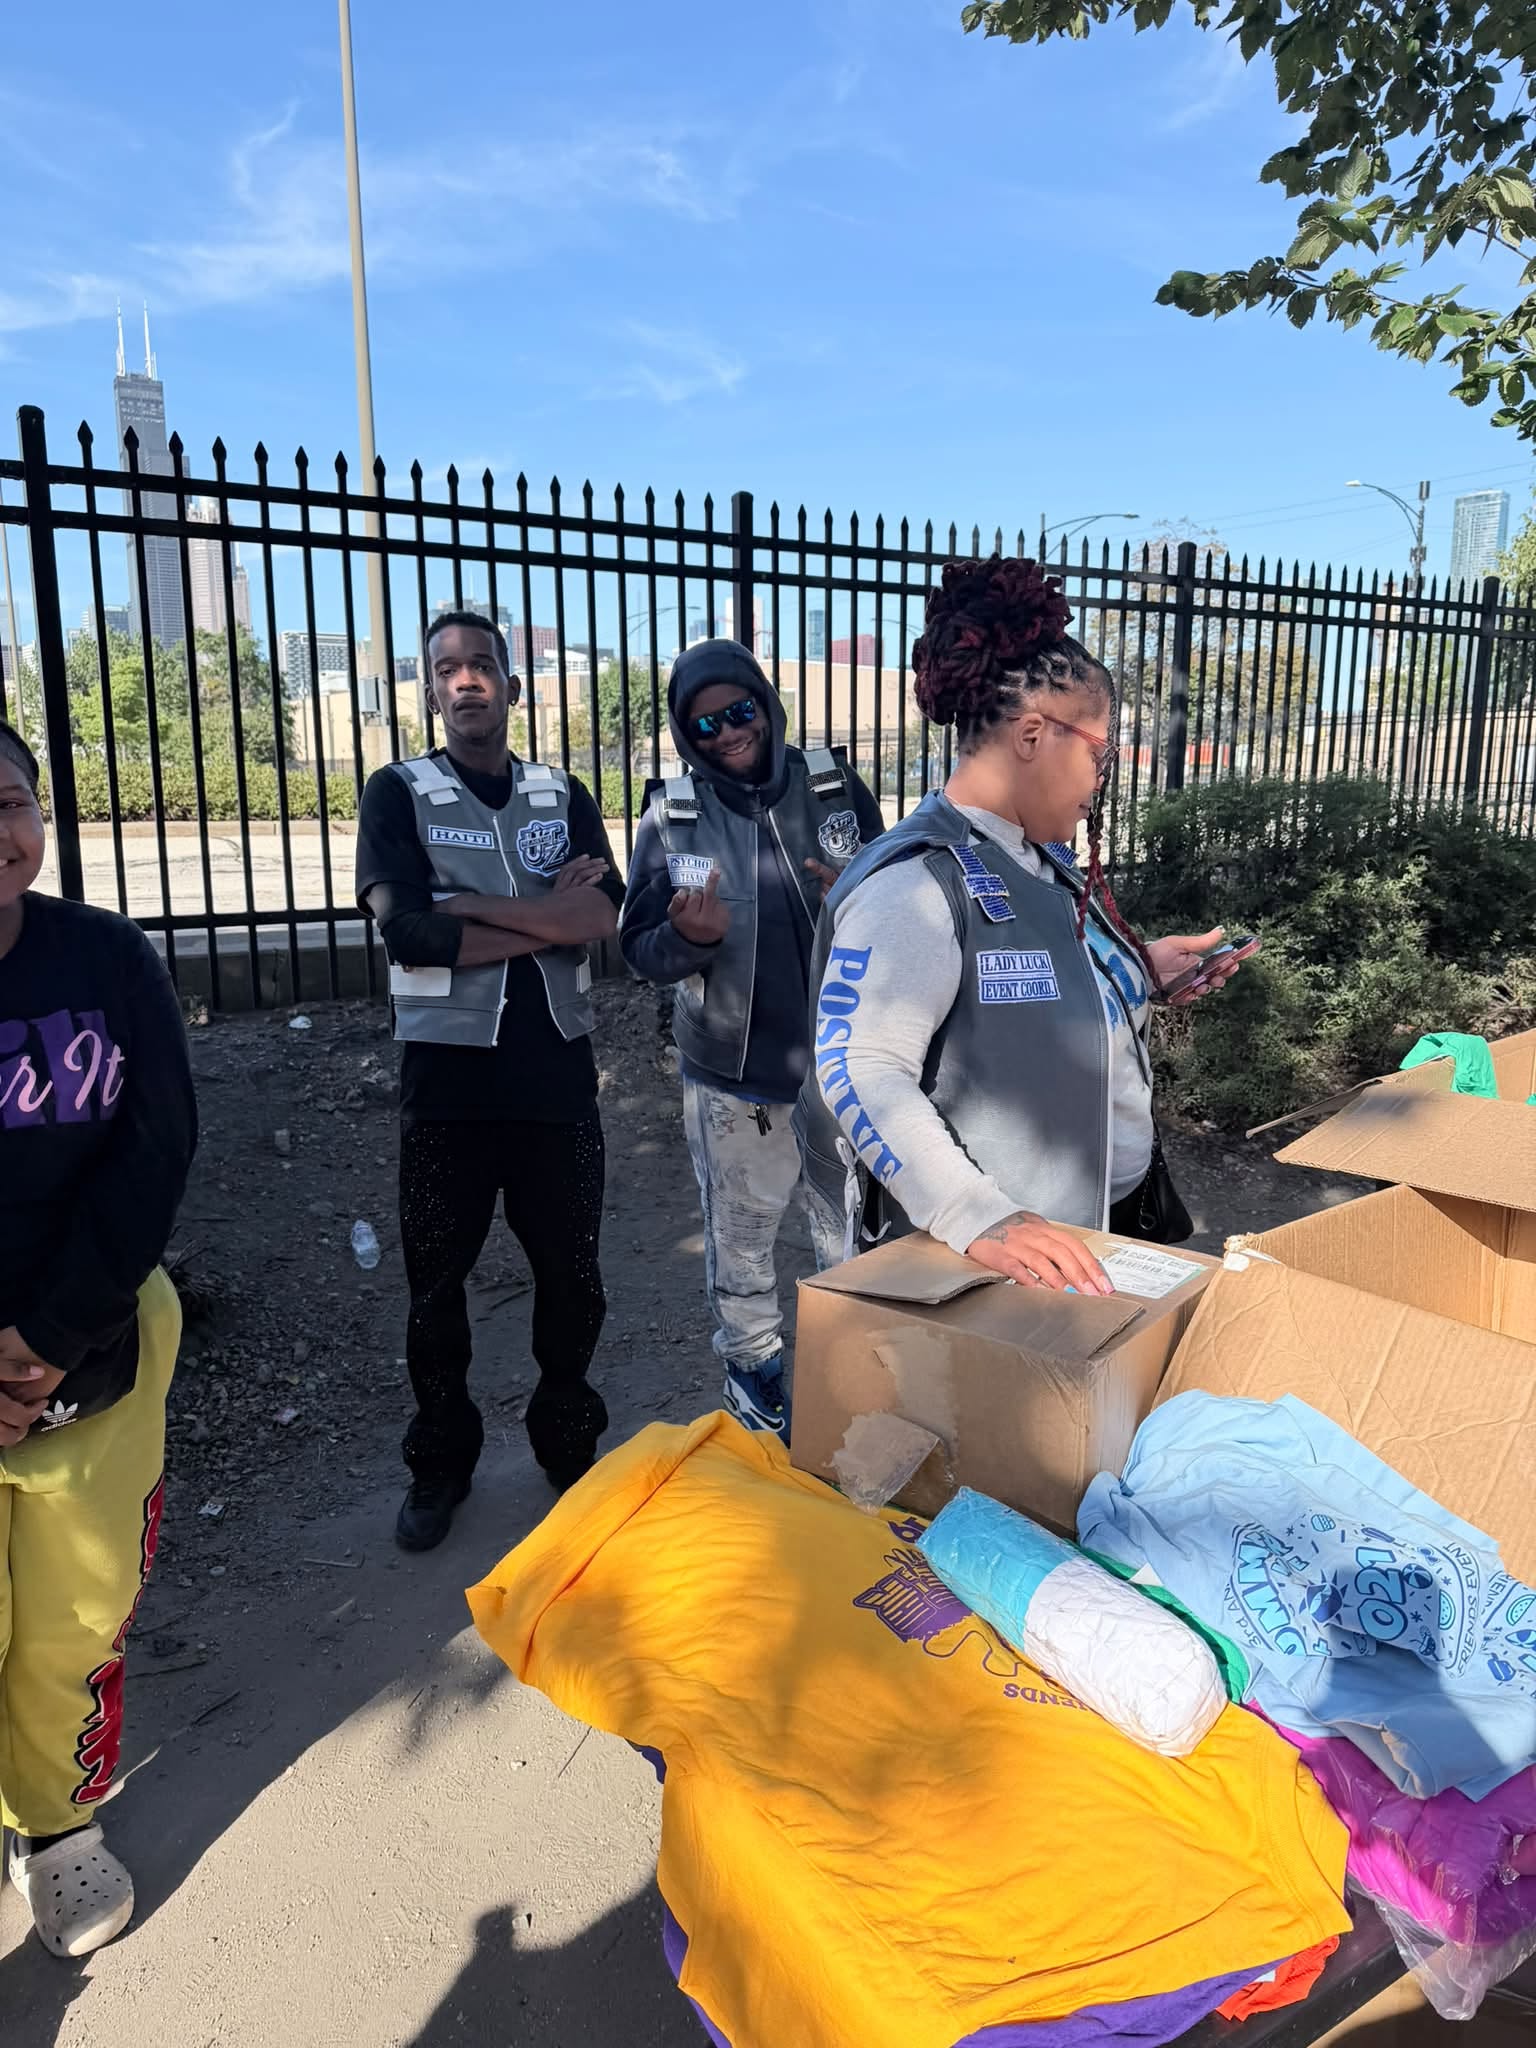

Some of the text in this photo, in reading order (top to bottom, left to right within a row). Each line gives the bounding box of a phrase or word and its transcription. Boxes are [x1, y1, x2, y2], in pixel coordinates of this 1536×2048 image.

[436, 830, 489, 844] HAITI
[671, 857, 709, 869] PSYCHO
[984, 954, 1049, 972] LADY LUCK
[985, 982, 1055, 998] EVENT COORD.
[0, 1029, 125, 1112] r It
[41, 1418, 77, 1431] adidas
[1443, 1541, 1478, 1675] FRIENDS EVENT
